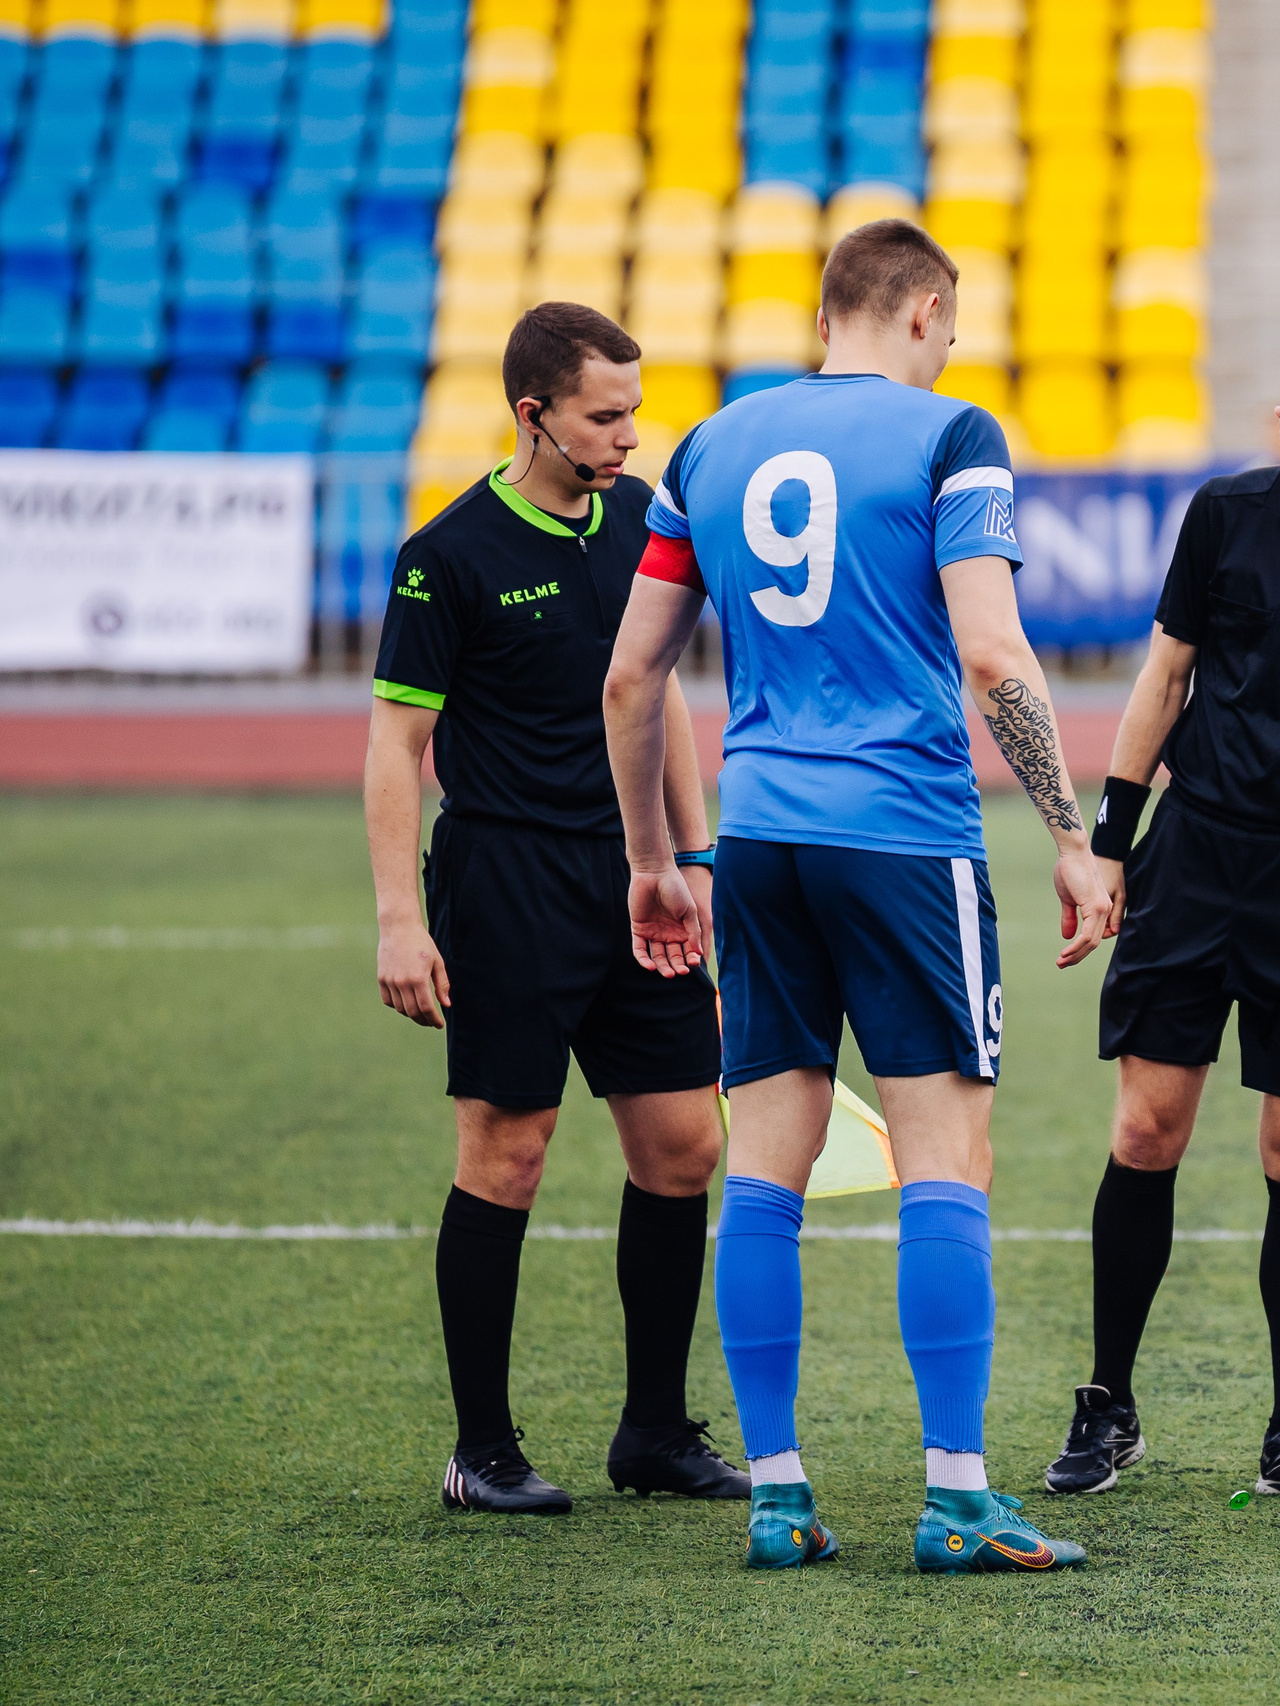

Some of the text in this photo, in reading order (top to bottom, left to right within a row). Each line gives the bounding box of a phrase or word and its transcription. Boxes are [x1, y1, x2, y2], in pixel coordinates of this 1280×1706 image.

[743, 450, 838, 627] 9
[396, 585, 432, 602] KELME
[499, 581, 561, 606] KELME
[986, 984, 1003, 1057] 9
